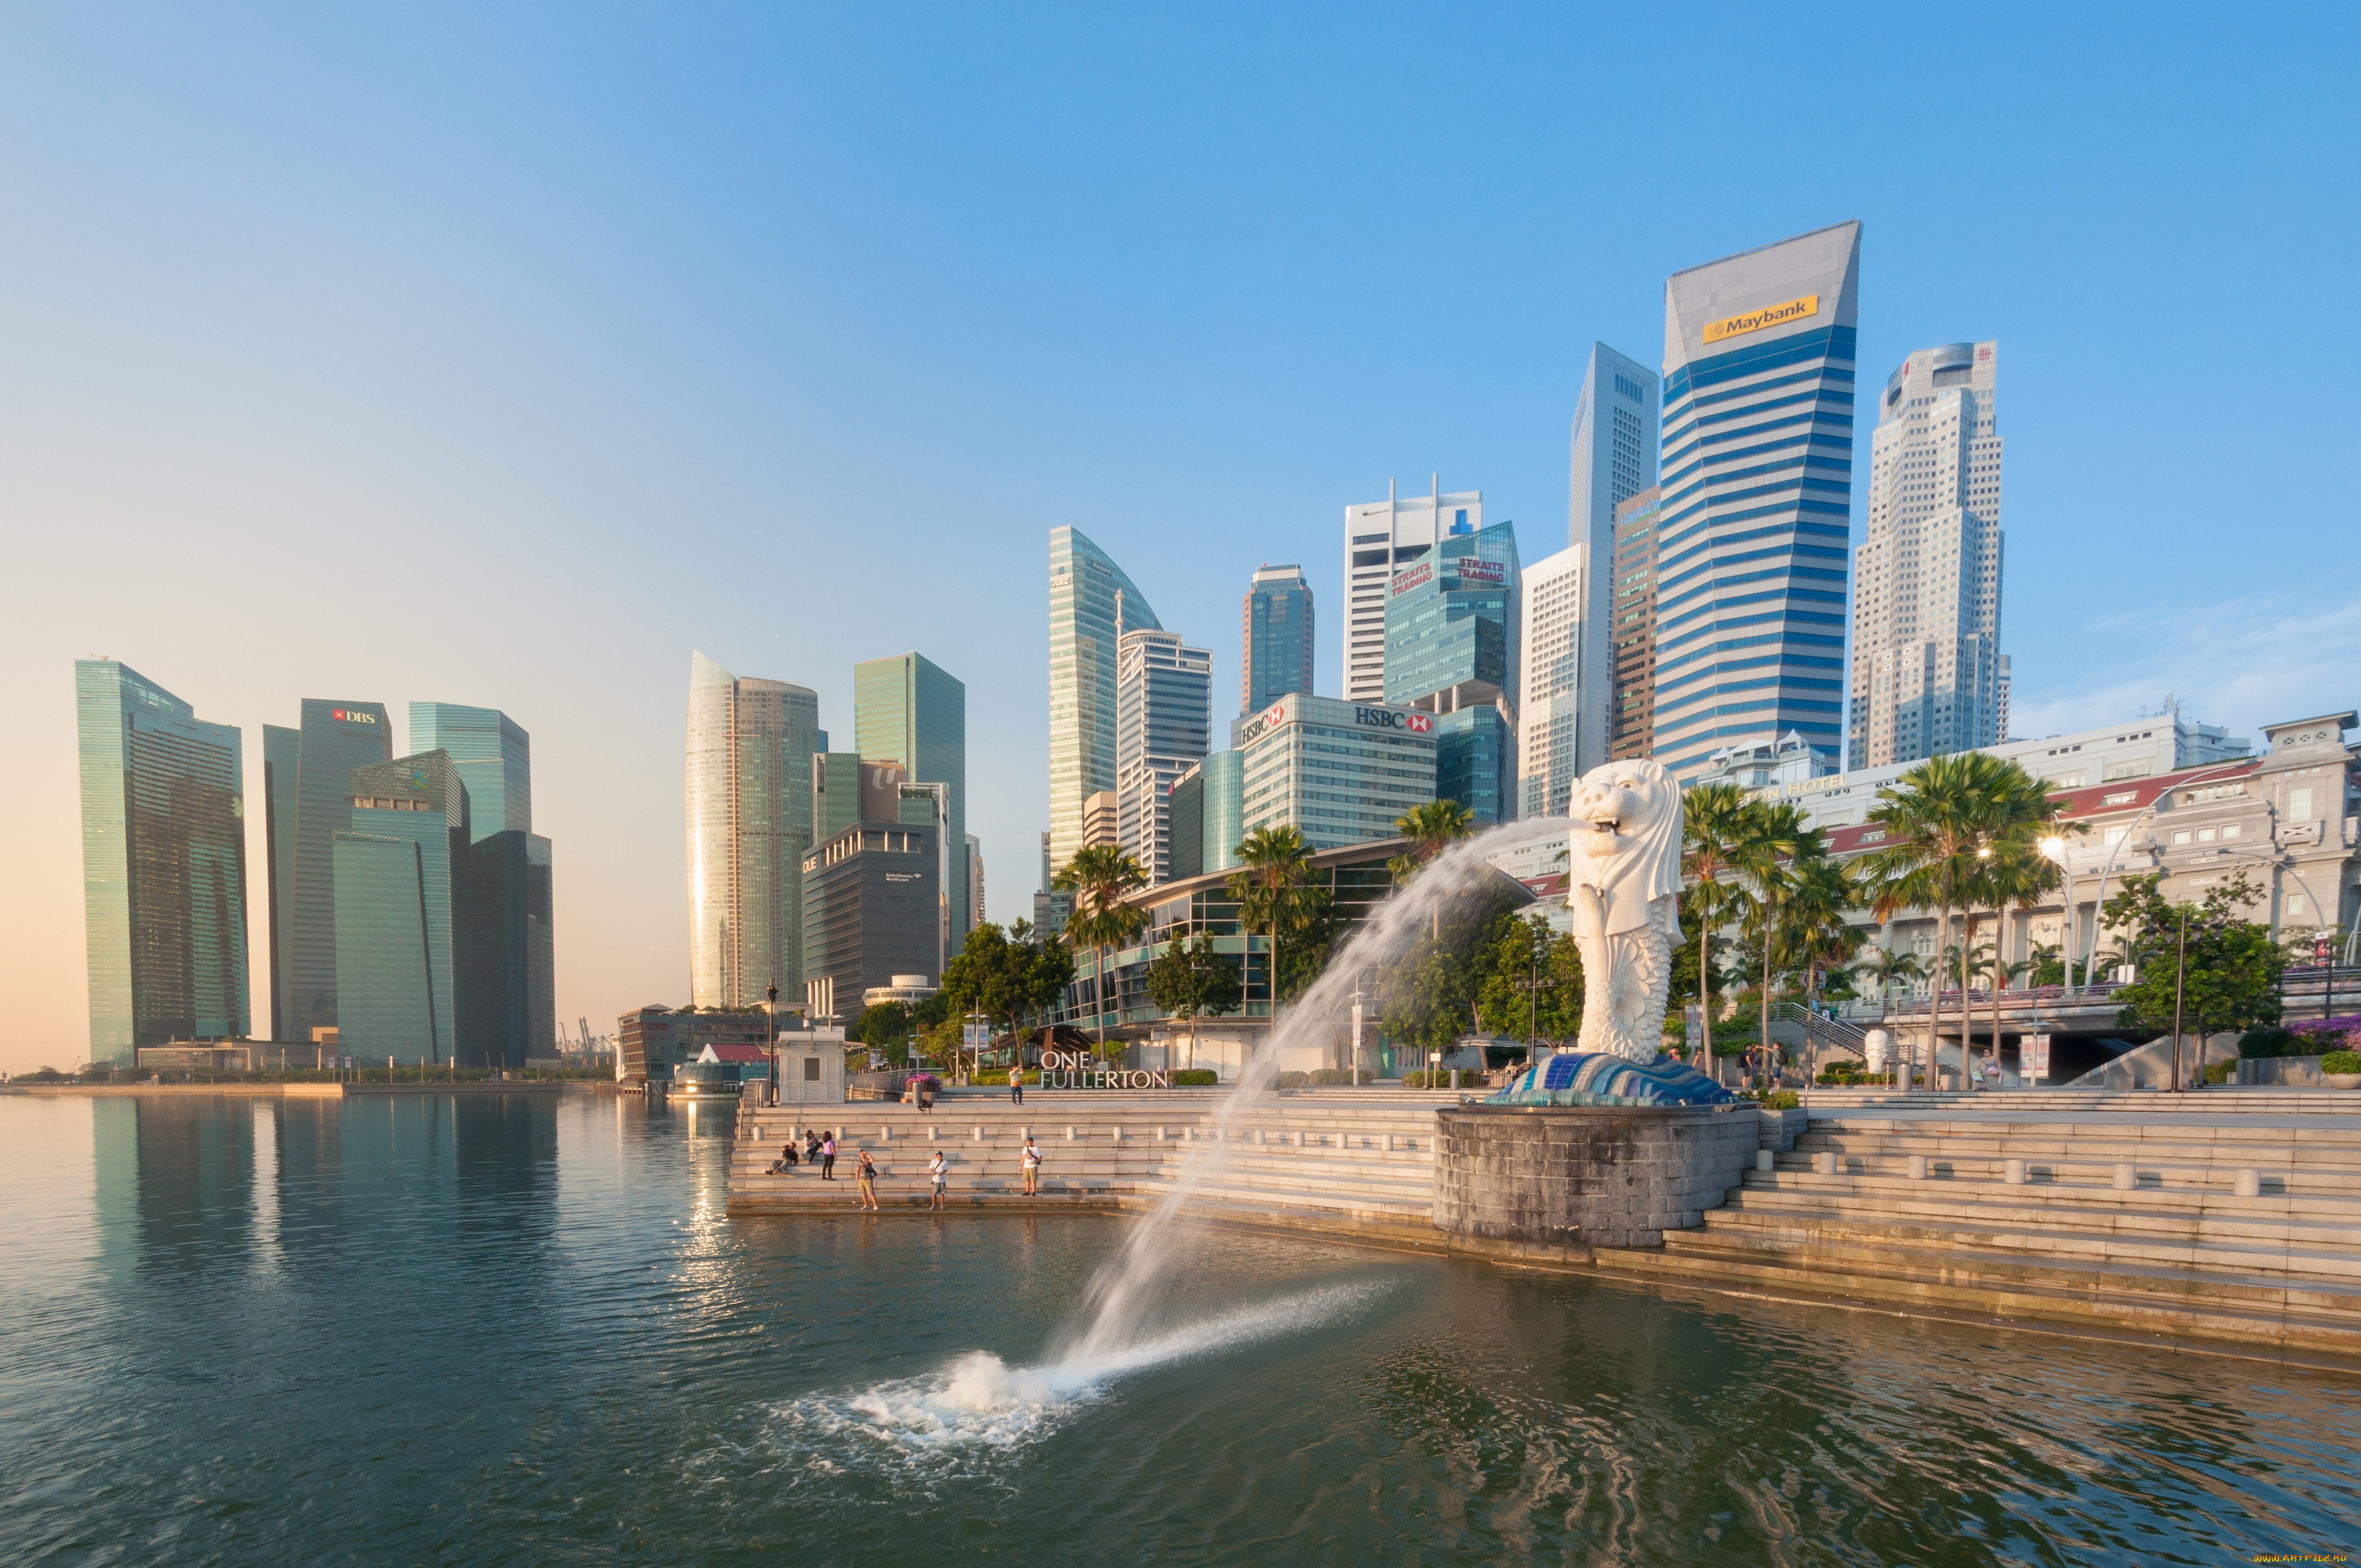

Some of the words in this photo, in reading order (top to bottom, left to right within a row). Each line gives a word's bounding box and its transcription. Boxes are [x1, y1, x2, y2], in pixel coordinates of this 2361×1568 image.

[1726, 301, 1807, 333] Maybank
[1392, 562, 1430, 587] STRAITS
[1459, 558, 1505, 572] STRAITS
[1052, 577, 1070, 588] ANZ
[1392, 572, 1432, 597] TRADING
[1456, 568, 1505, 582] TRADING
[346, 711, 375, 724] DBS
[1355, 707, 1404, 729] HSBC
[1241, 713, 1269, 745] HSBC
[1789, 774, 1848, 795] HOTEL
[803, 856, 816, 874] OUE
[1040, 1051, 1090, 1069] ONE
[1040, 1070, 1168, 1089] FULLERTON
